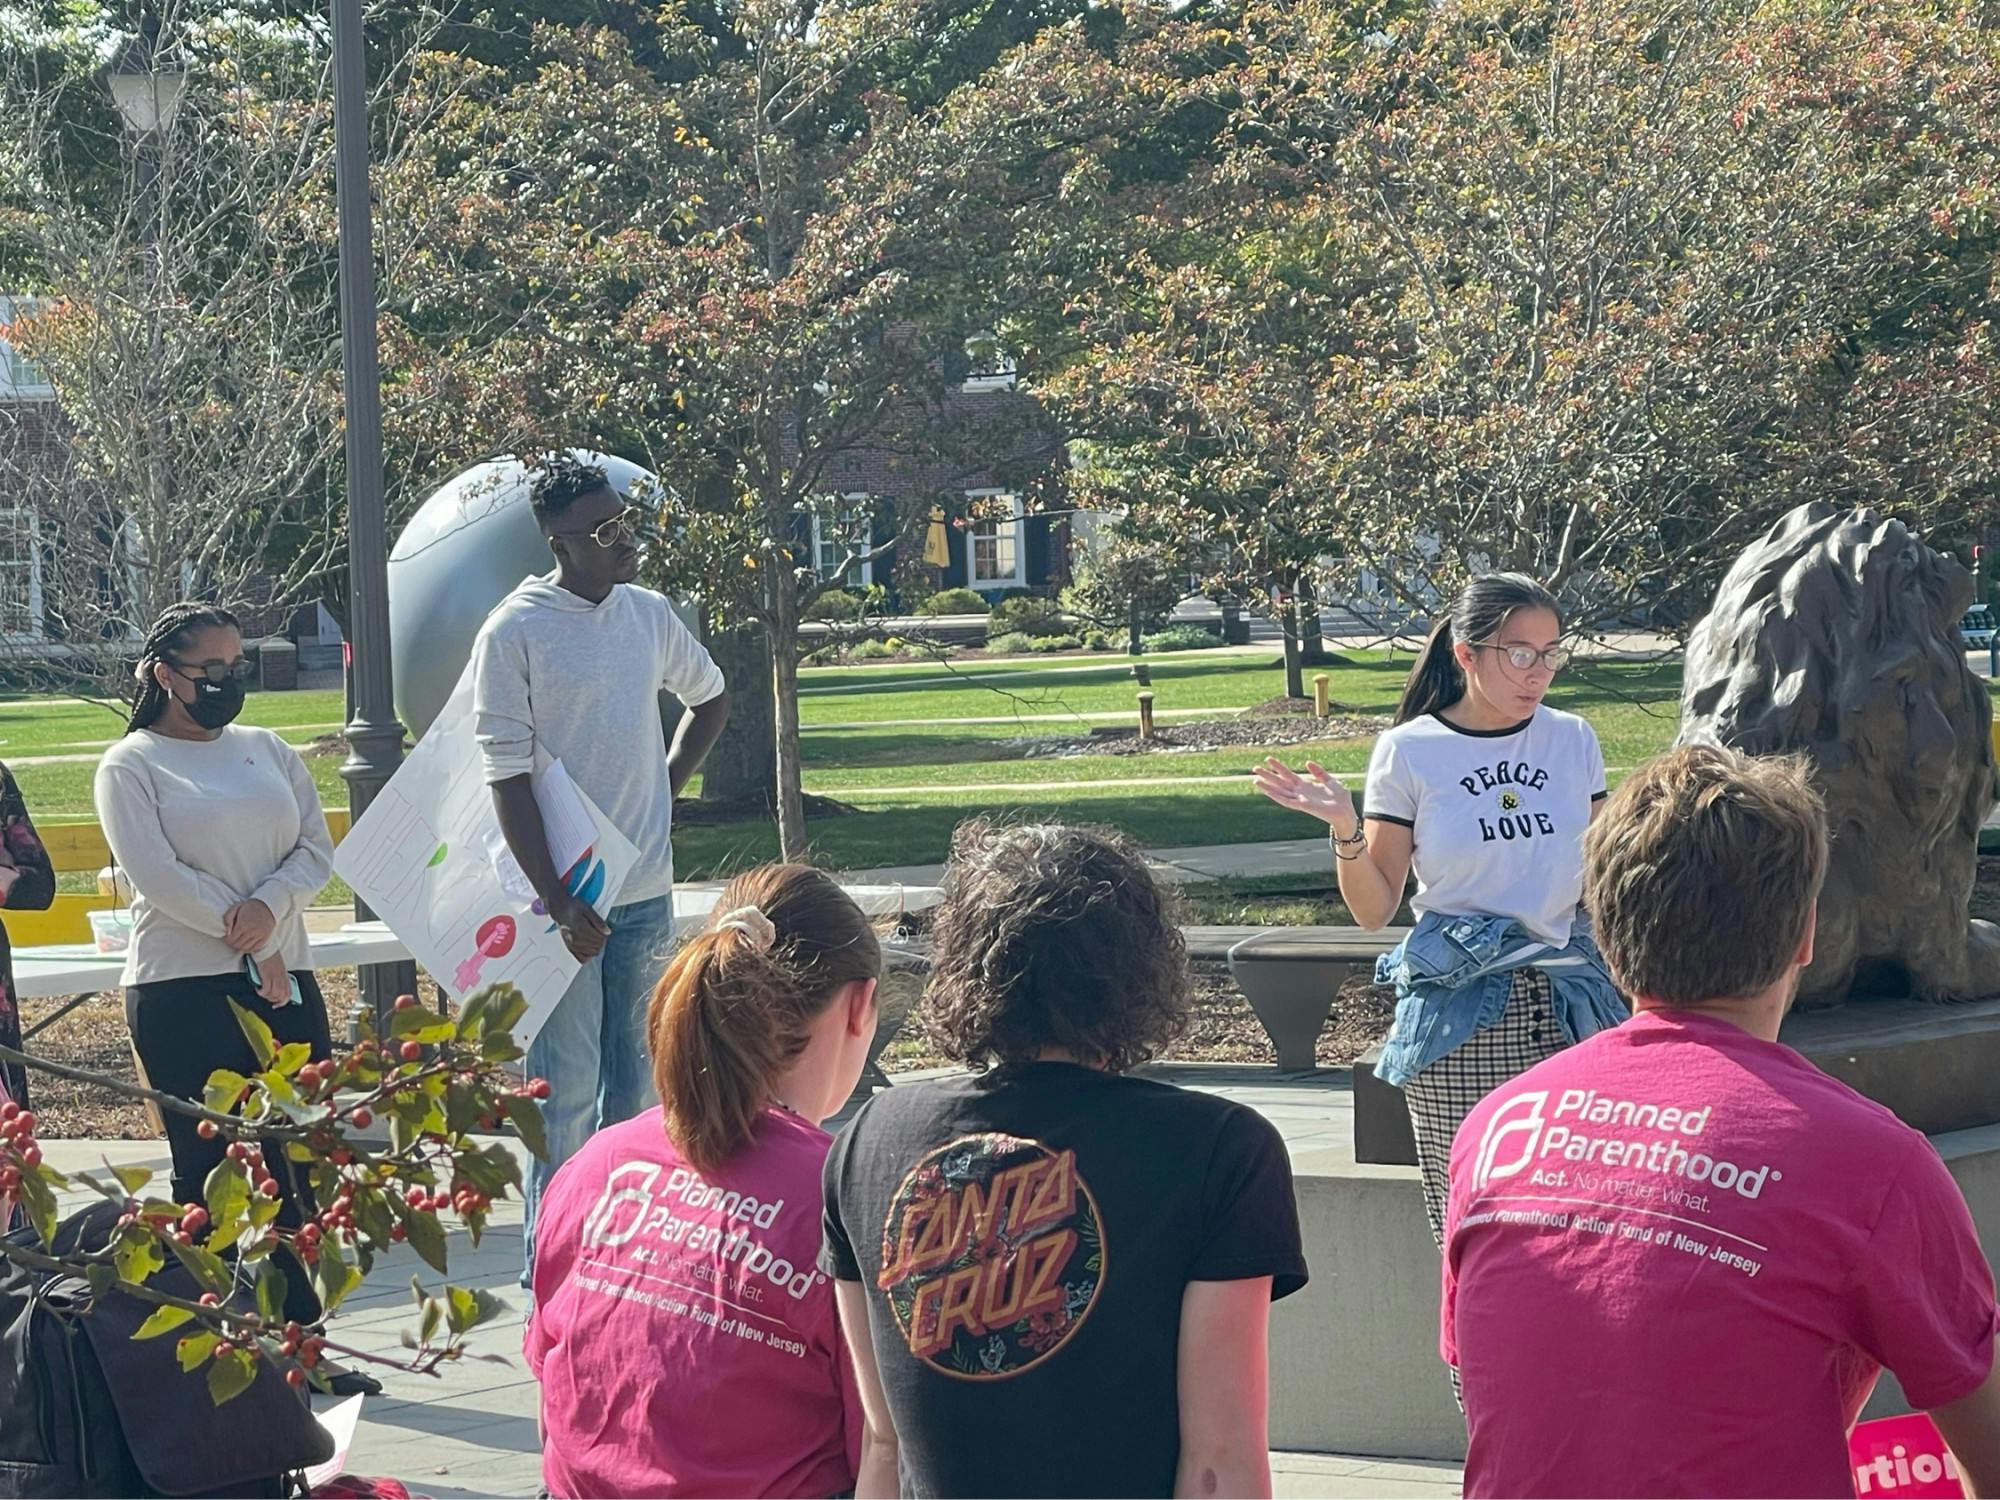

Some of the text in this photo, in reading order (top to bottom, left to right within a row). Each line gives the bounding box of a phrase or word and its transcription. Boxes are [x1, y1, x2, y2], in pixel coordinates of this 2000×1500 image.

[1459, 761, 1549, 796] PEACE
[1502, 794, 1518, 809] &
[1478, 813, 1555, 841] LOVE
[1554, 1089, 1712, 1136] Planned
[660, 1168, 784, 1230] Planned
[1530, 1168, 1569, 1187] Act.
[1573, 1171, 1598, 1191] No
[1601, 1178, 1659, 1199] matter
[878, 1149, 1077, 1289] SANTA
[1495, 1210, 1568, 1228] Parenthood
[1572, 1215, 1613, 1235] Action
[1617, 1222, 1653, 1243] Fund
[1655, 1230, 1672, 1247] of
[1673, 1235, 1709, 1258] New
[1709, 1241, 1762, 1278] Jersey
[910, 1227, 1078, 1358] CRUZ
[690, 1305, 719, 1328] Fund
[720, 1320, 736, 1334] of
[736, 1322, 765, 1342] New
[766, 1333, 807, 1357] Jersey
